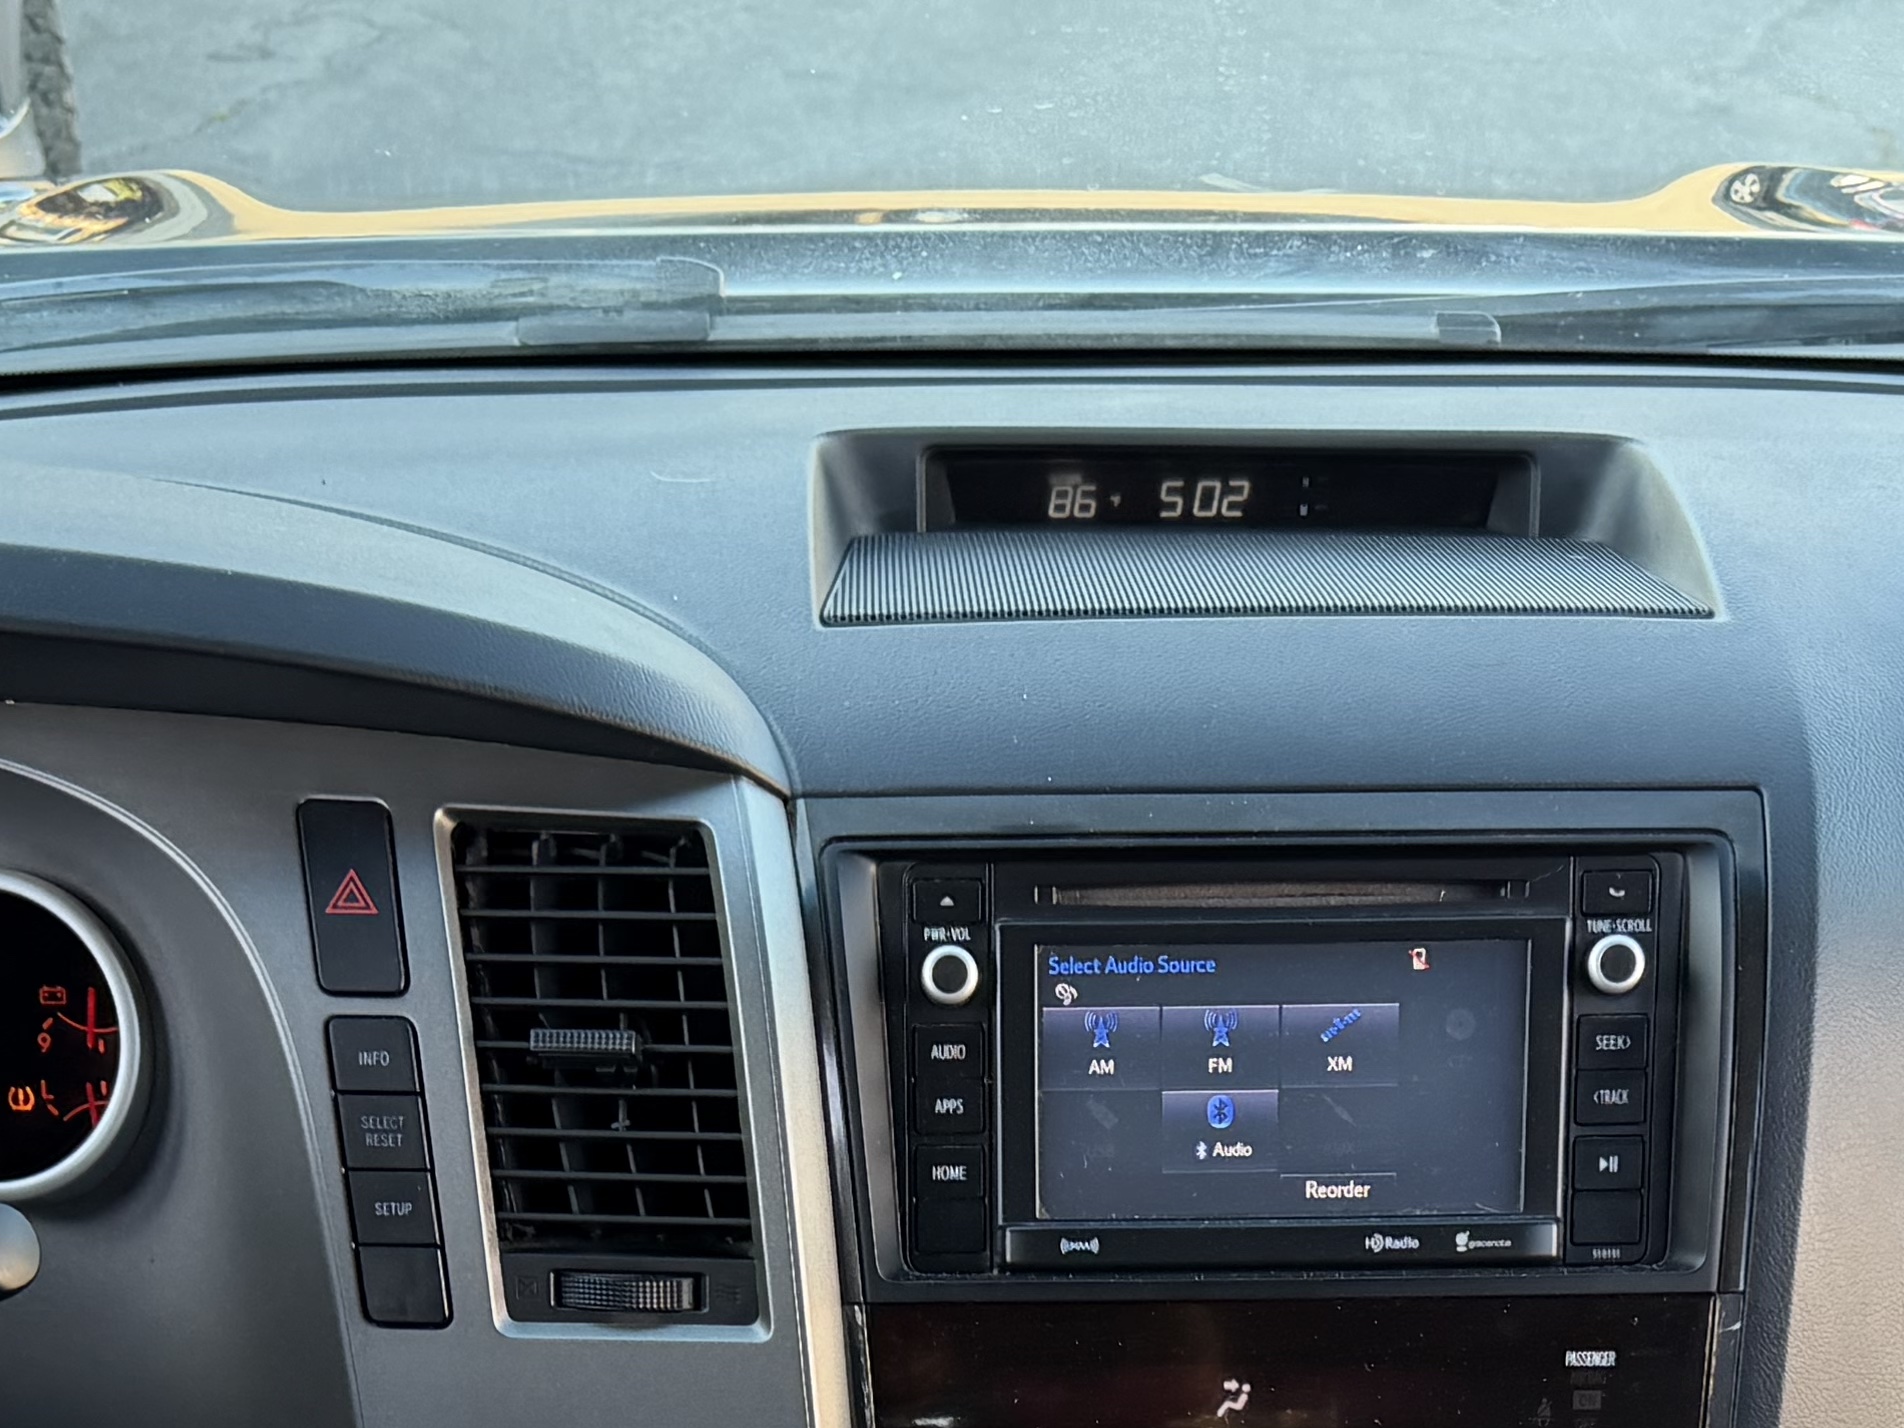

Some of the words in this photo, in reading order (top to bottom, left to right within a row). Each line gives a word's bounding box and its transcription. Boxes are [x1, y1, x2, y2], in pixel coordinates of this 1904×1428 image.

[1048, 485, 1097, 519] 86
[1048, 955, 1101, 976] Select
[1104, 955, 1154, 975] Audio
[1157, 954, 1217, 974] Source
[358, 1050, 390, 1067] INFO
[930, 1044, 966, 1061] AUDIO
[1088, 1058, 1115, 1075] AM
[1208, 1057, 1233, 1074] FM
[1326, 1055, 1354, 1073] XM
[934, 1098, 965, 1115] APPS
[360, 1115, 405, 1130] SELECT
[365, 1133, 403, 1148] RESET
[1212, 1141, 1253, 1158] Audio
[931, 1165, 967, 1182] HOME
[1304, 1180, 1372, 1199] Reorder
[374, 1201, 413, 1217] SETUP
[1384, 1235, 1421, 1250] Radio
[1565, 1350, 1617, 1368] PASSENGER
